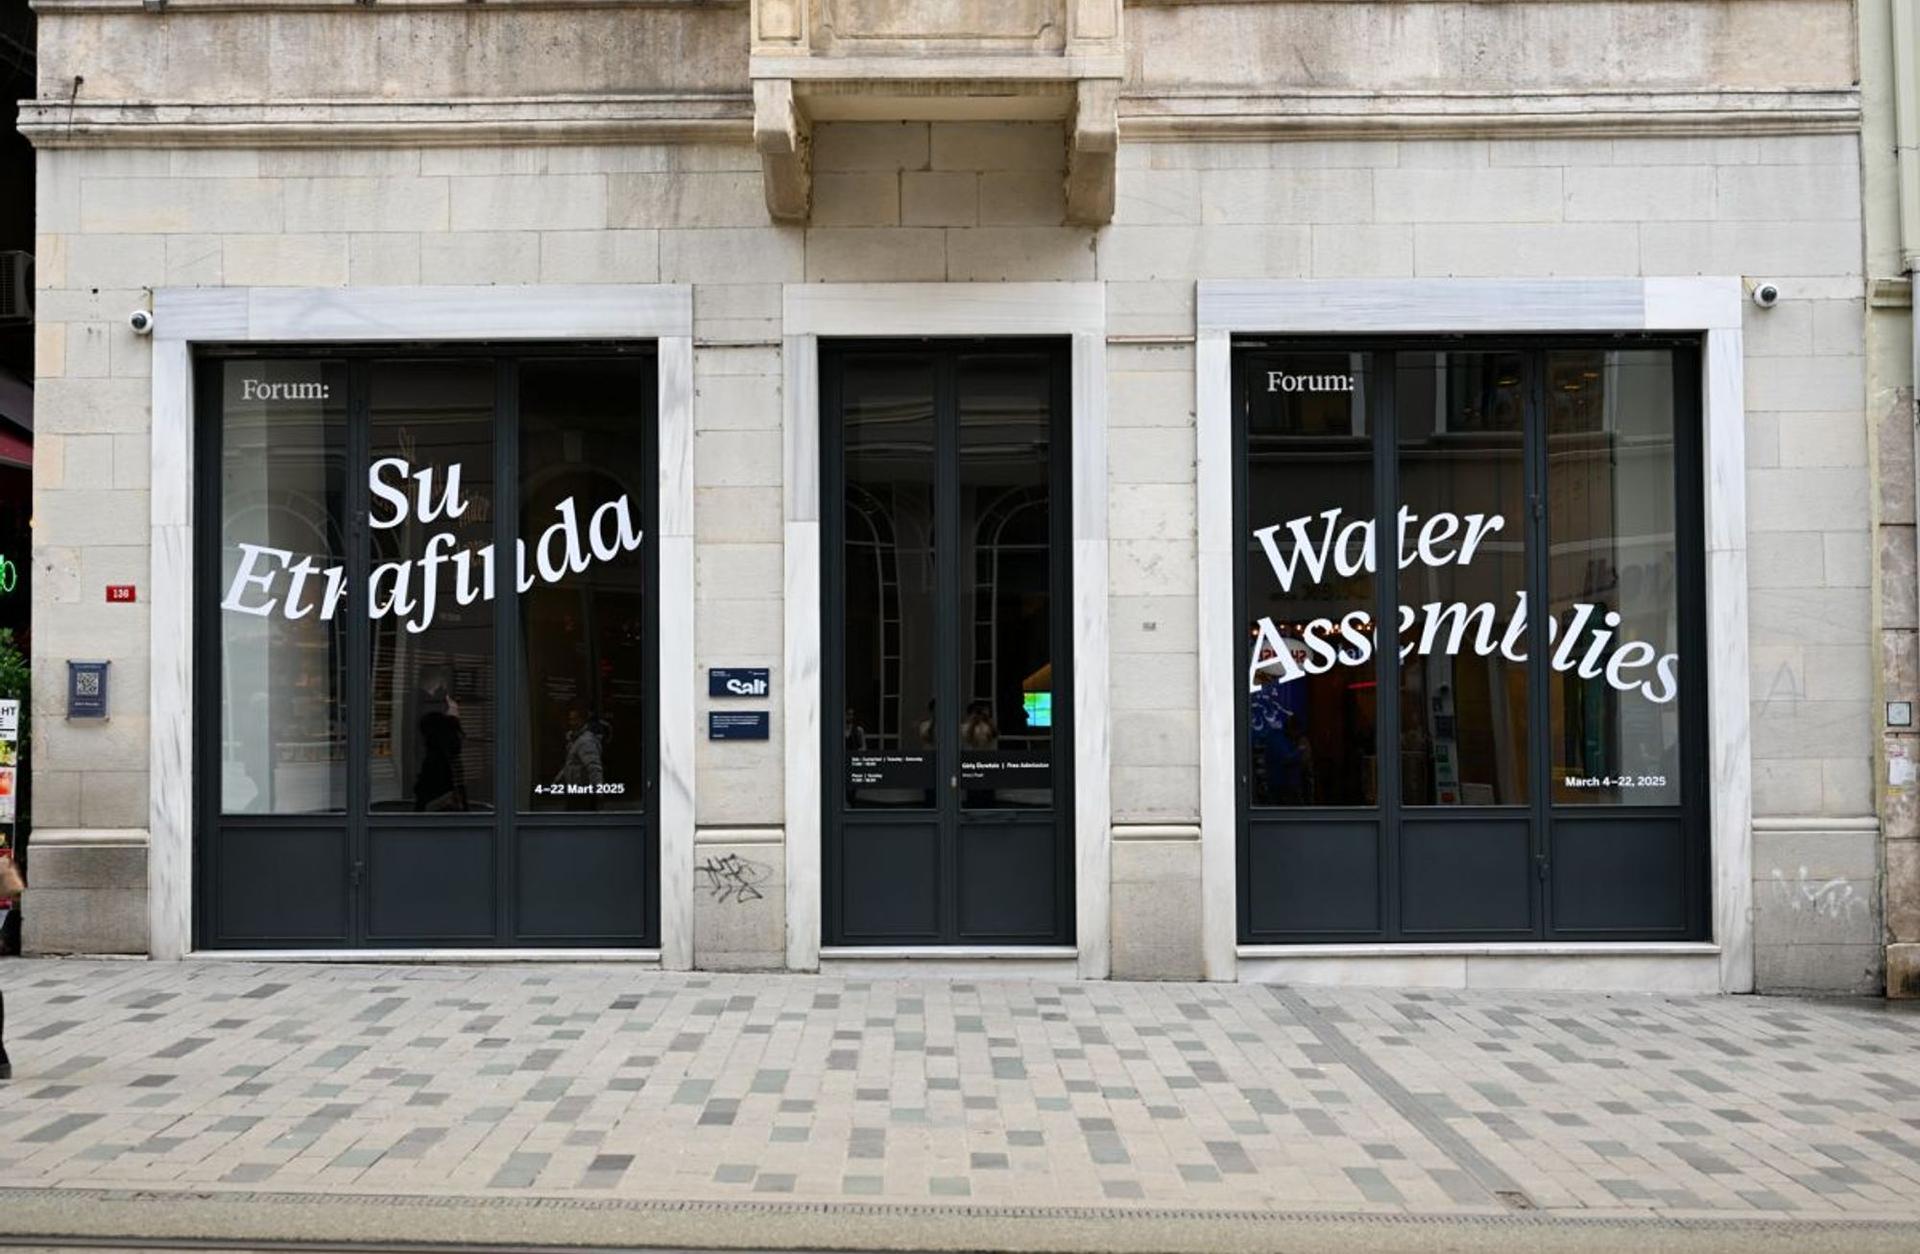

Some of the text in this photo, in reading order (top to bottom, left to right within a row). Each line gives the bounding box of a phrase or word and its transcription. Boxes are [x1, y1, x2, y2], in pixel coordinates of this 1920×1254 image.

[242, 378, 329, 400] Forum:
[1267, 371, 1355, 392] Forum:
[369, 457, 469, 528] Su
[1253, 505, 1505, 592] Water
[1249, 591, 1679, 703] Assemblies
[726, 678, 767, 694] Salt
[567, 783, 593, 794] Mart
[596, 783, 625, 794] 2025
[1565, 776, 1600, 787] March
[1637, 776, 1667, 787] 2025
